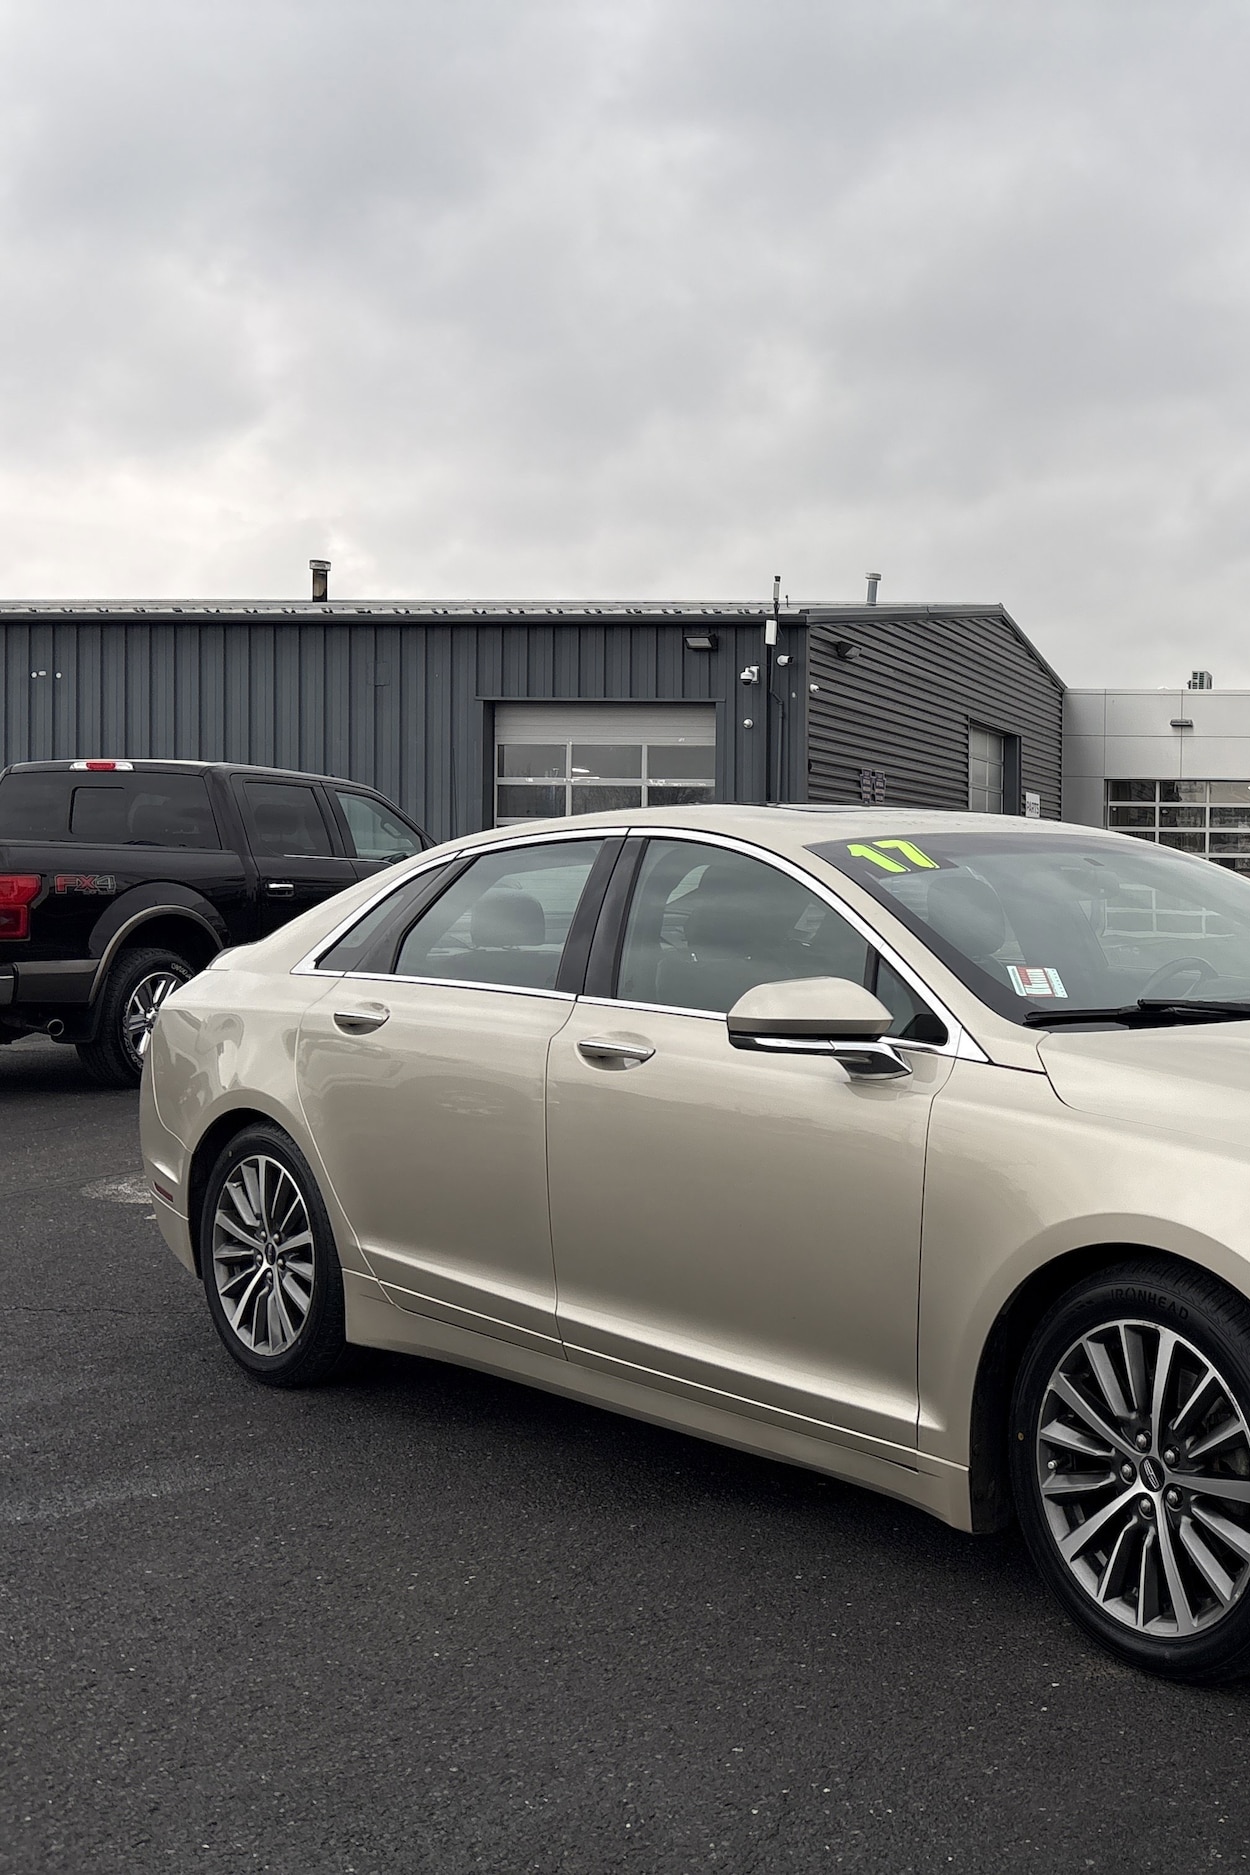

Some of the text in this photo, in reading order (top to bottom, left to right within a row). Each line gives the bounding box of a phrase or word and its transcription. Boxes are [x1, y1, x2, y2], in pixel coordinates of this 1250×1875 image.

[846, 839, 941, 873] 17
[54, 873, 117, 895] FX4
[1111, 1287, 1189, 1320] IRONHEAD
